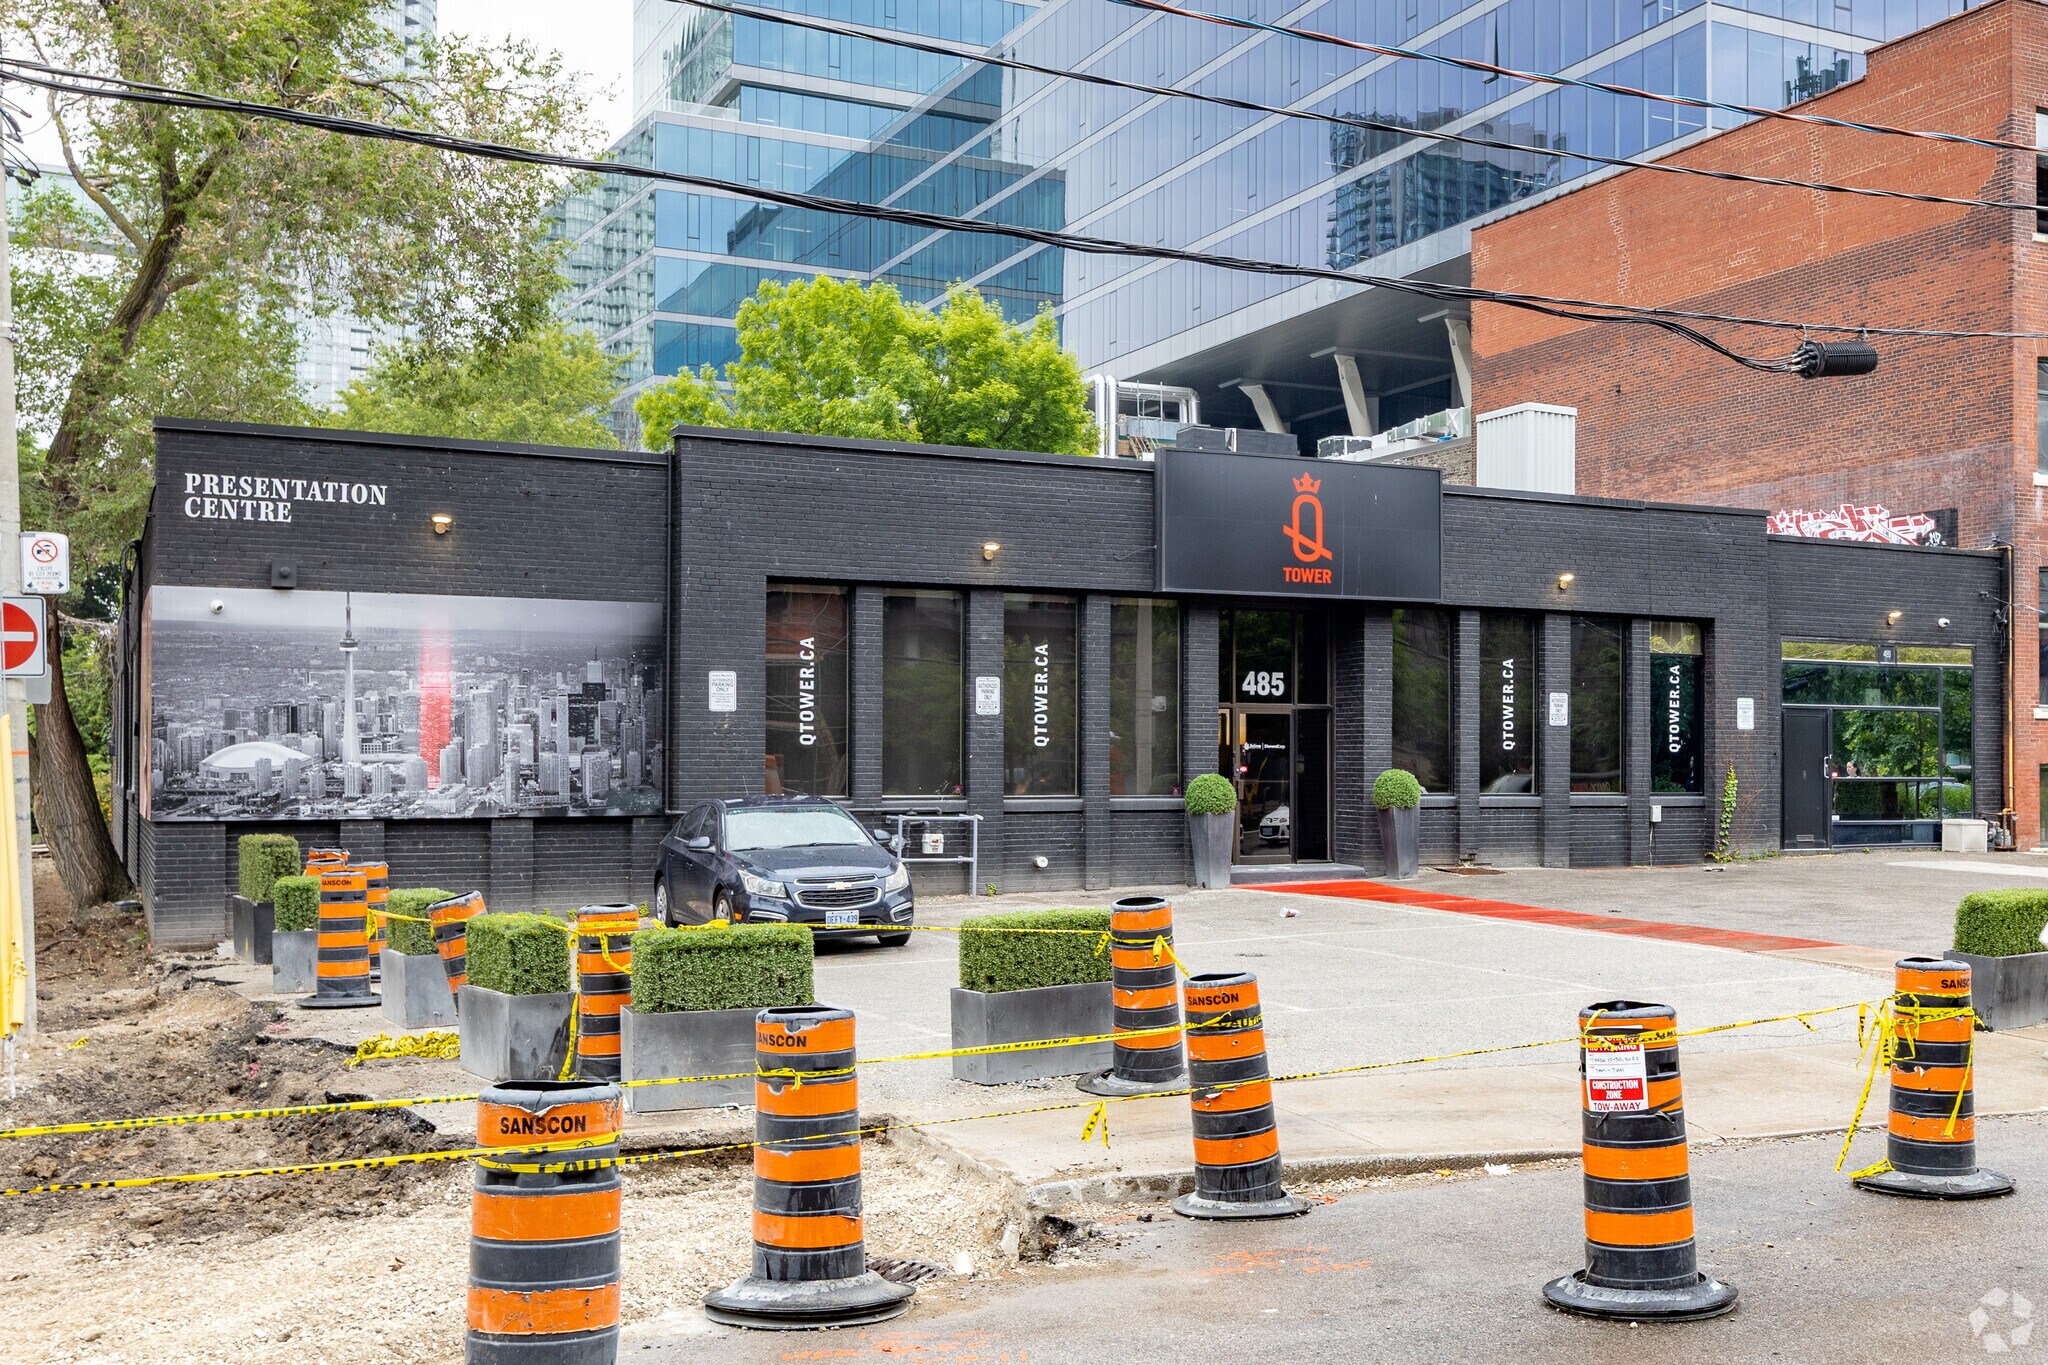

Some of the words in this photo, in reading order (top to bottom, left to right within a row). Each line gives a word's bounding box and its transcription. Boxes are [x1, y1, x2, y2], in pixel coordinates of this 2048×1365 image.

[184, 472, 388, 506] PRESENTATION
[184, 496, 293, 523] CENTRE
[1283, 567, 1332, 584] TOWER
[799, 636, 817, 746] QTOWER.CA
[1033, 643, 1050, 748] QTOWER.CA
[1241, 670, 1285, 697] 485
[1502, 658, 1517, 751] QTOWER.CA
[1668, 664, 1682, 753] QTOWER.CA
[1187, 992, 1239, 1006] SANSCON
[757, 1031, 807, 1048] ANSCON
[1592, 1079, 1639, 1090] CONSTRUCTION
[1605, 1090, 1622, 1100] ZONE
[1593, 1101, 1641, 1111] TOW-AWAY
[500, 1114, 587, 1135] SANSCON
